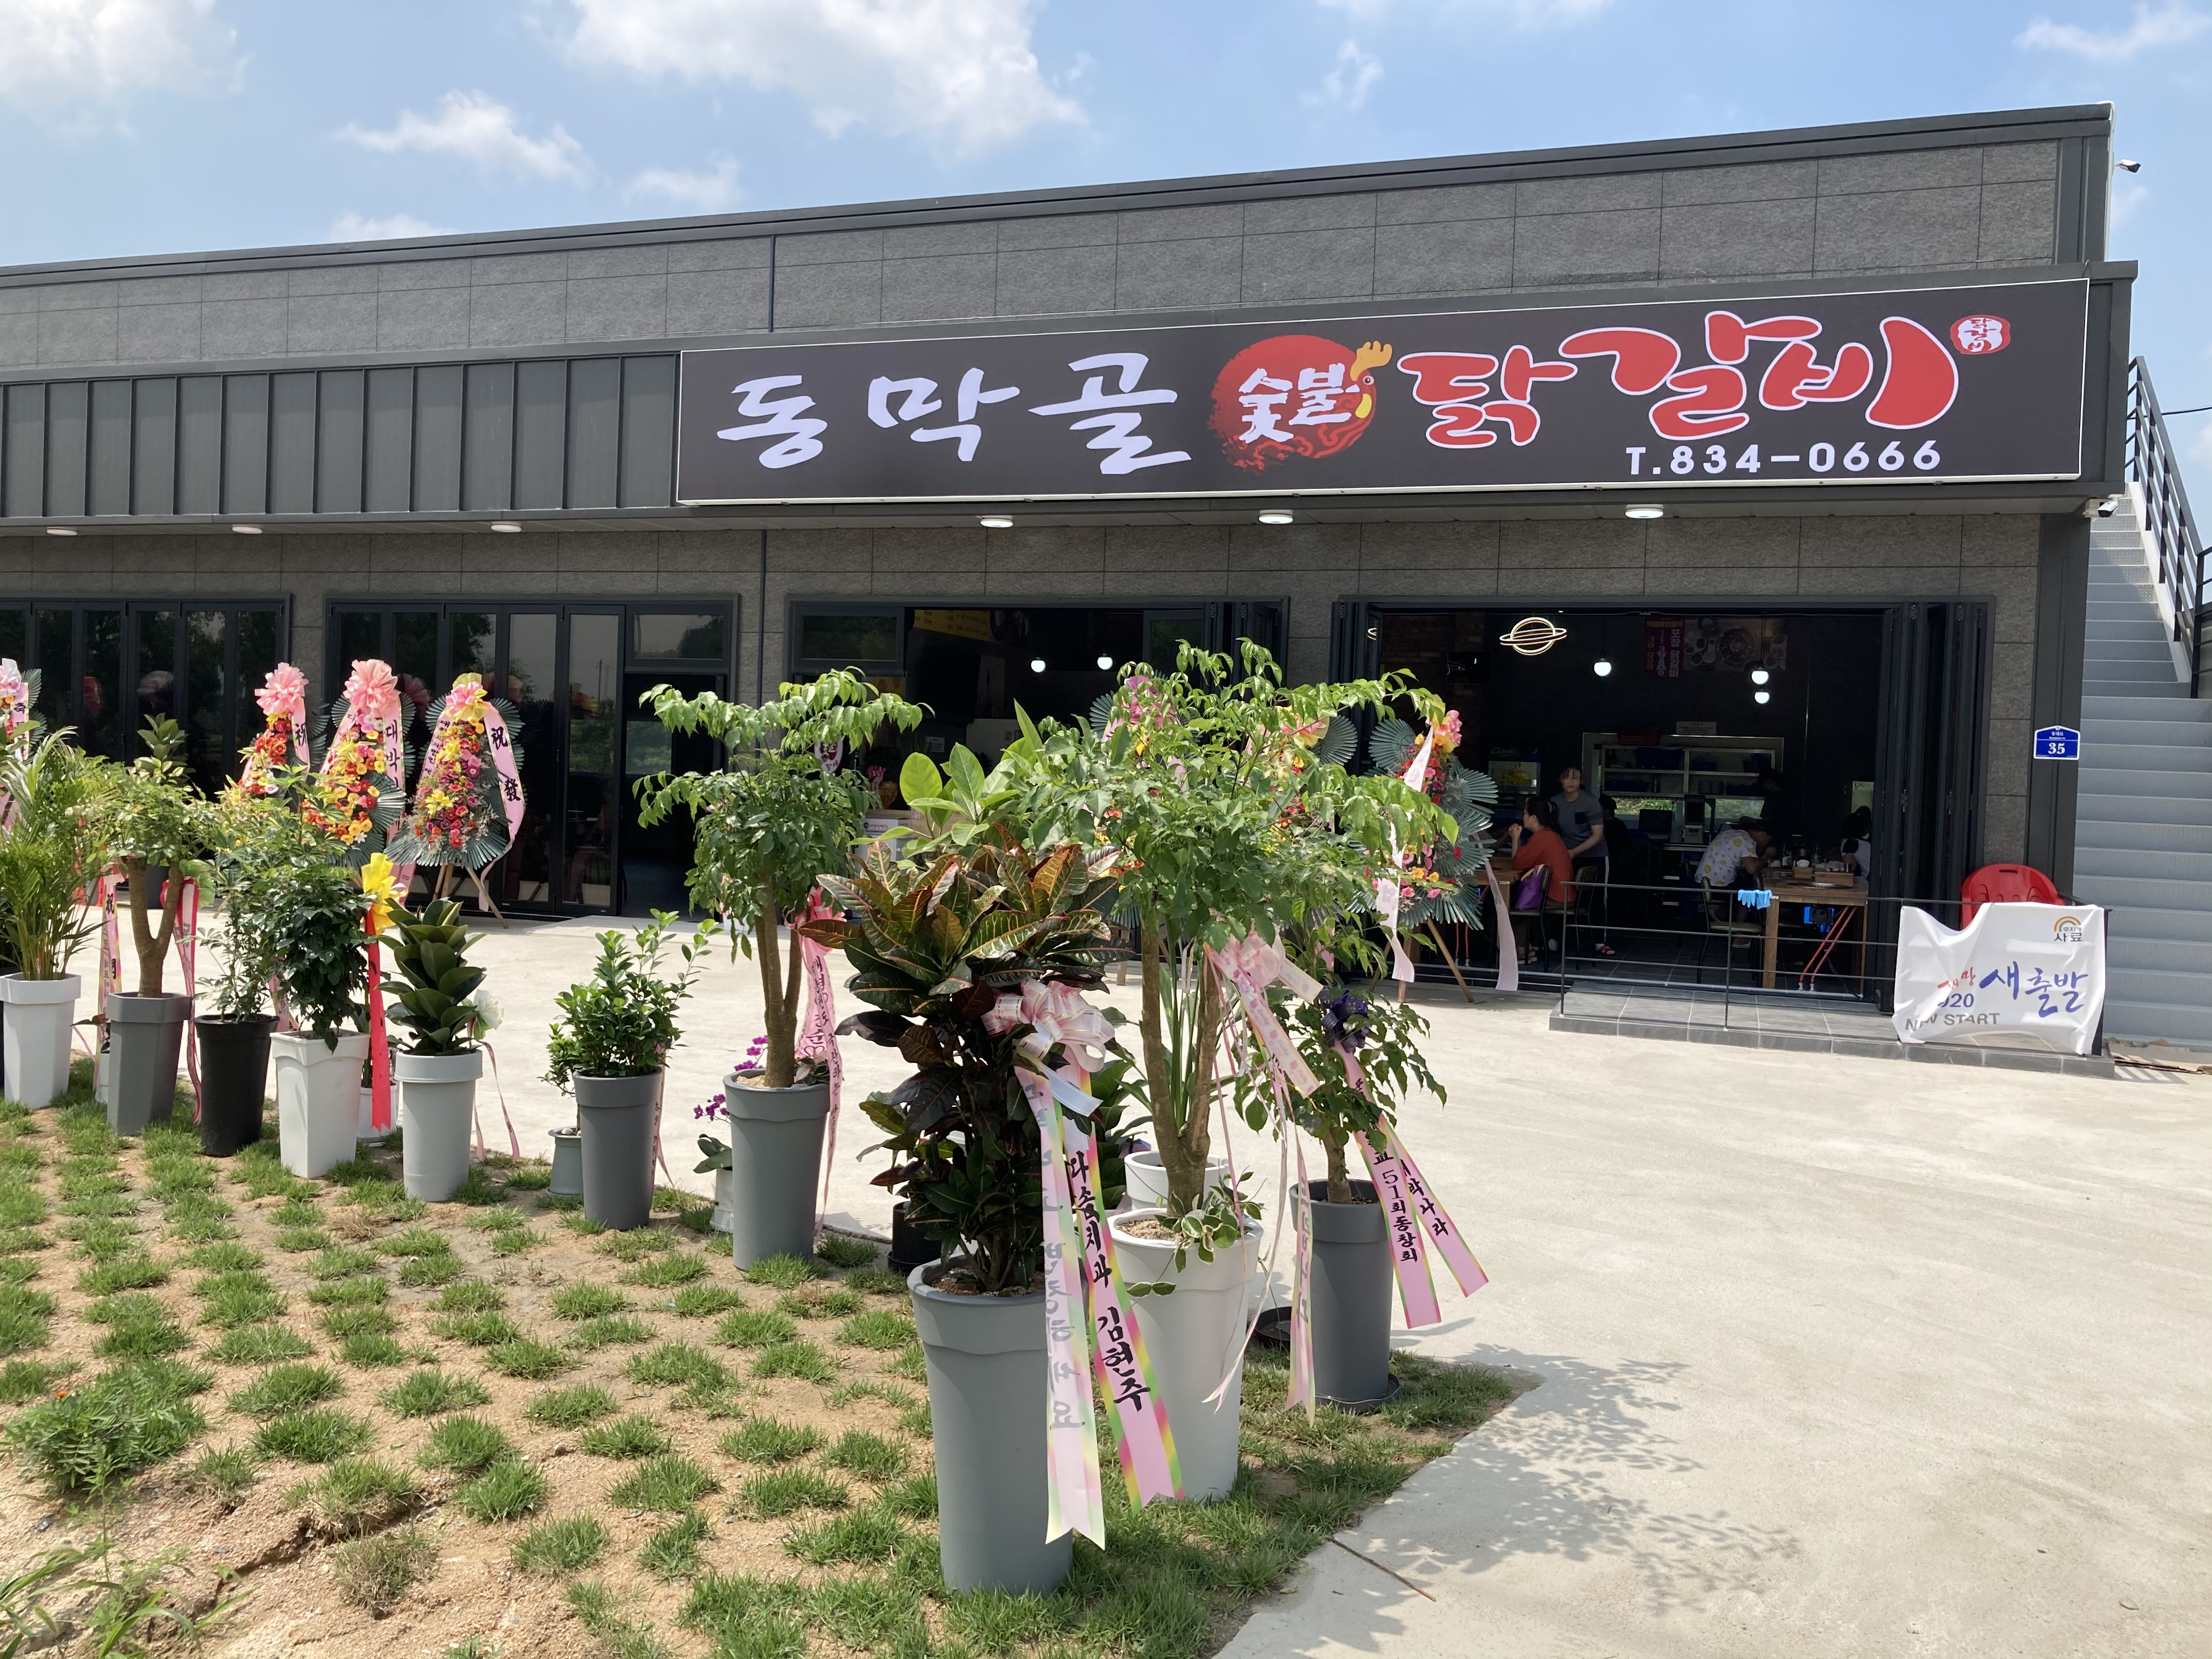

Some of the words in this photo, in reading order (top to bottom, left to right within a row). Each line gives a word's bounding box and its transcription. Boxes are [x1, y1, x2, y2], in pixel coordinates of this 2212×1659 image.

[716, 352, 1192, 475] 동막골
[1238, 363, 1356, 443] 숯불
[1397, 310, 1959, 449] 닭갈비
[491, 726, 509, 751] 祝
[2048, 742, 2066, 754] 35
[2054, 933, 2083, 943] 사료
[1979, 961, 2089, 1018] 새출발
[1905, 1013, 1938, 1032] NW
[1098, 1306, 1151, 1412] 김현주
